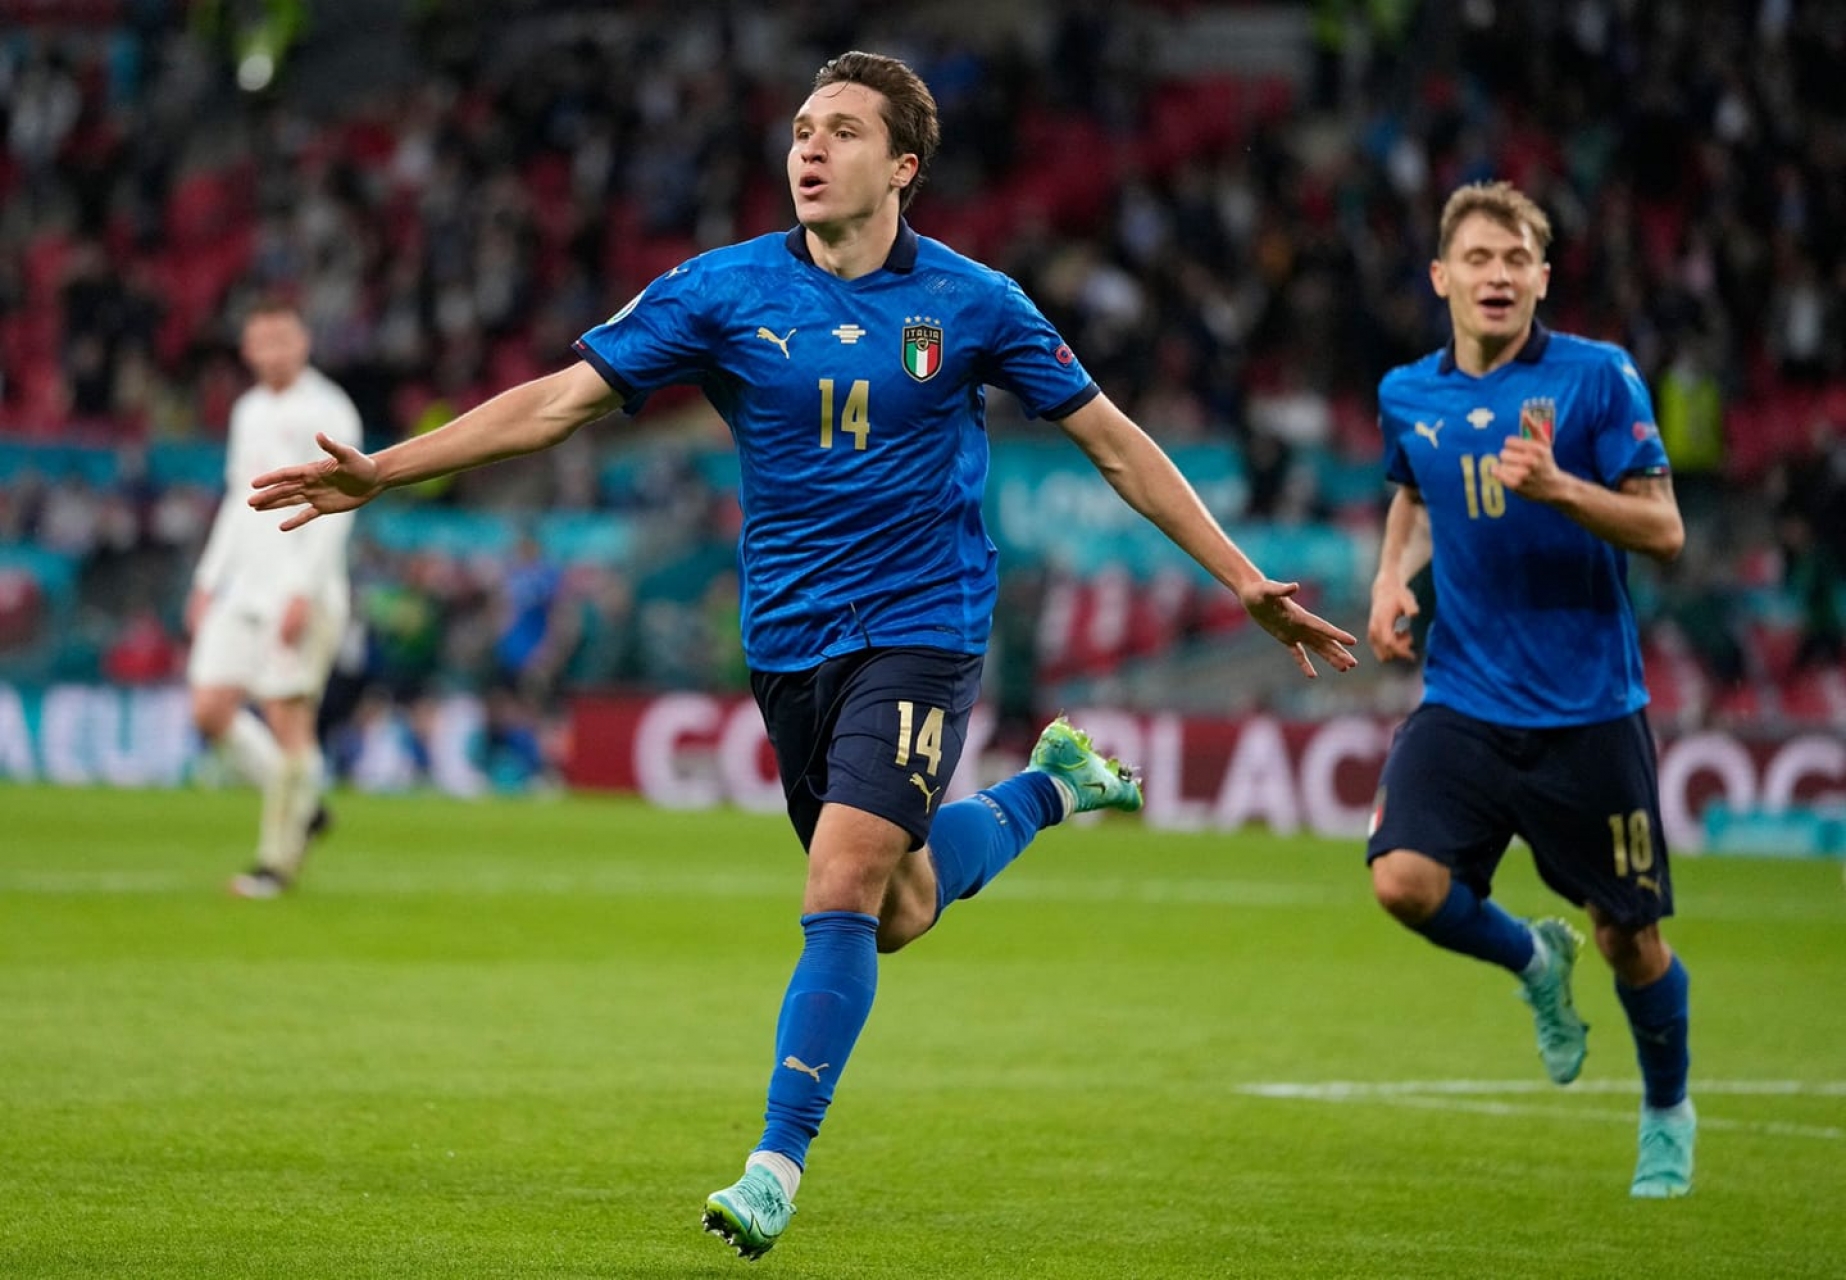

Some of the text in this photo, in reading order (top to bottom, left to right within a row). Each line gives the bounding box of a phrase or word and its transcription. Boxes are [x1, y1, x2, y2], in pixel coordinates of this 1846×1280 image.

[906, 329, 939, 339] ITALIA
[819, 378, 870, 450] 14
[895, 701, 944, 777] 14
[1608, 809, 1653, 877] 18
